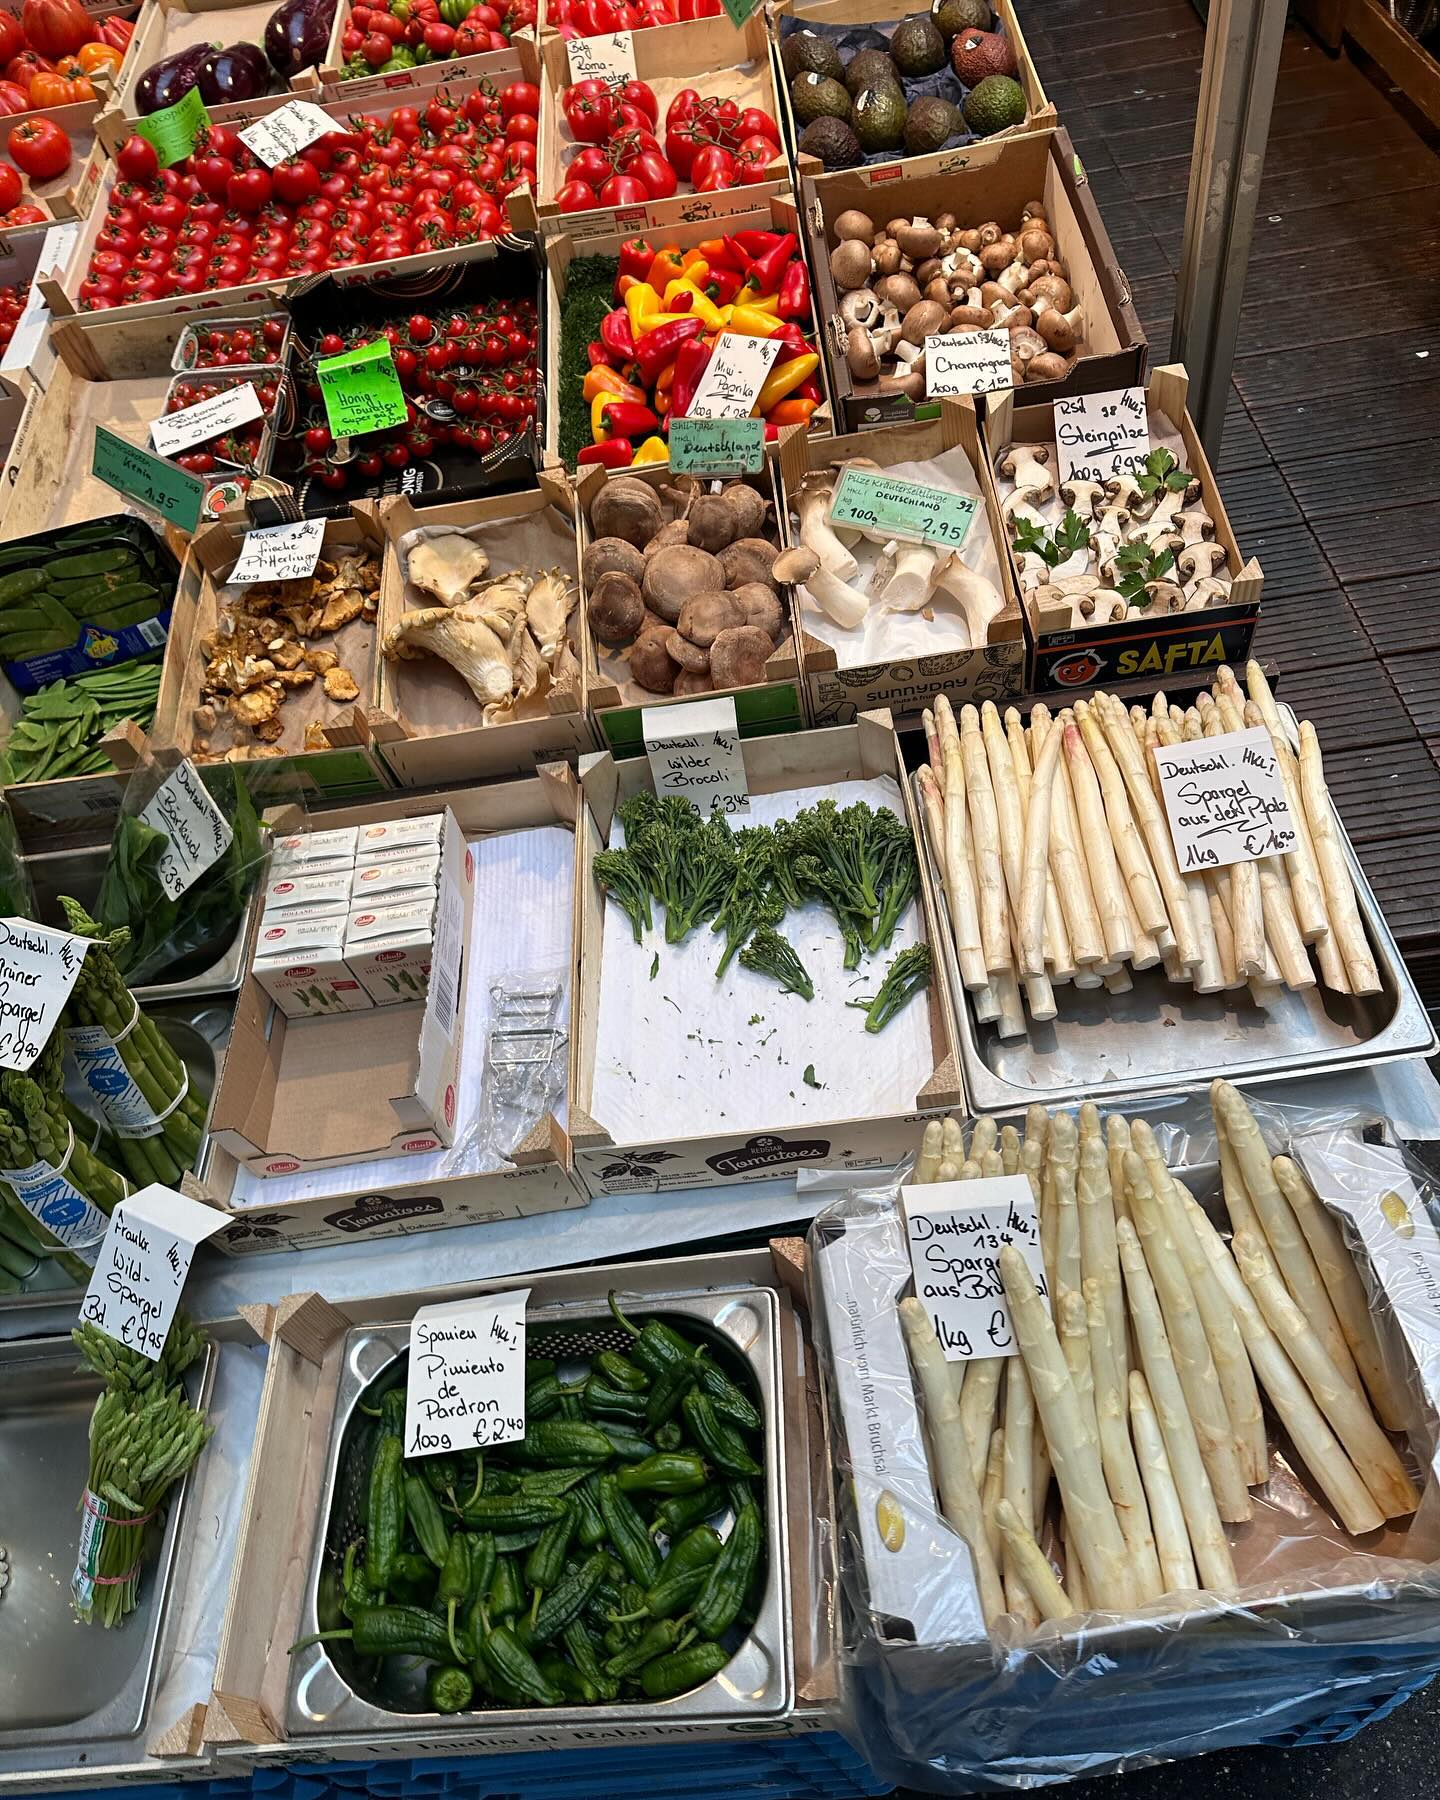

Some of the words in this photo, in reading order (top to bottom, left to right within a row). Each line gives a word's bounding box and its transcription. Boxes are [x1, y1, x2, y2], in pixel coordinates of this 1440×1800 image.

[720, 336, 731, 349] NL
[321, 374, 338, 385] NL
[714, 374, 754, 398] Paprika
[930, 382, 959, 394] 100g
[1058, 423, 1149, 450] Steinpilze
[401, 468, 417, 495] ONIG
[847, 474, 870, 486] Pilze
[872, 478, 948, 504] Kräuterseitlinge
[956, 500, 973, 513] 92
[850, 507, 878, 525] 100g
[257, 540, 298, 556] frische
[1116, 632, 1226, 674] SAFTA
[646, 738, 704, 752] Deutschl.
[662, 768, 729, 787] Brocoli
[1160, 755, 1236, 779] Deutschl.
[1178, 780, 1251, 813] Spargel
[1178, 814, 1210, 827] aus
[1239, 796, 1289, 824] Pfalz
[1186, 844, 1219, 866] 1kg
[716, 1149, 824, 1171] Tomatoes
[336, 1203, 438, 1228] Tomatoes
[910, 1214, 999, 1241] Deutschl.
[113, 1247, 150, 1282] Wild-
[107, 1272, 163, 1325] Spargel
[924, 1284, 960, 1298] aus
[417, 1324, 477, 1352] Spanien
[935, 1314, 972, 1355] 1kg
[417, 1354, 504, 1379] Pimiento
[855, 1353, 869, 1381] vom
[438, 1381, 460, 1399] de
[860, 1381, 879, 1420] Markt
[418, 1398, 499, 1420] Pardron
[410, 1424, 451, 1453] 100g
[867, 1421, 890, 1477] Bruchsal
